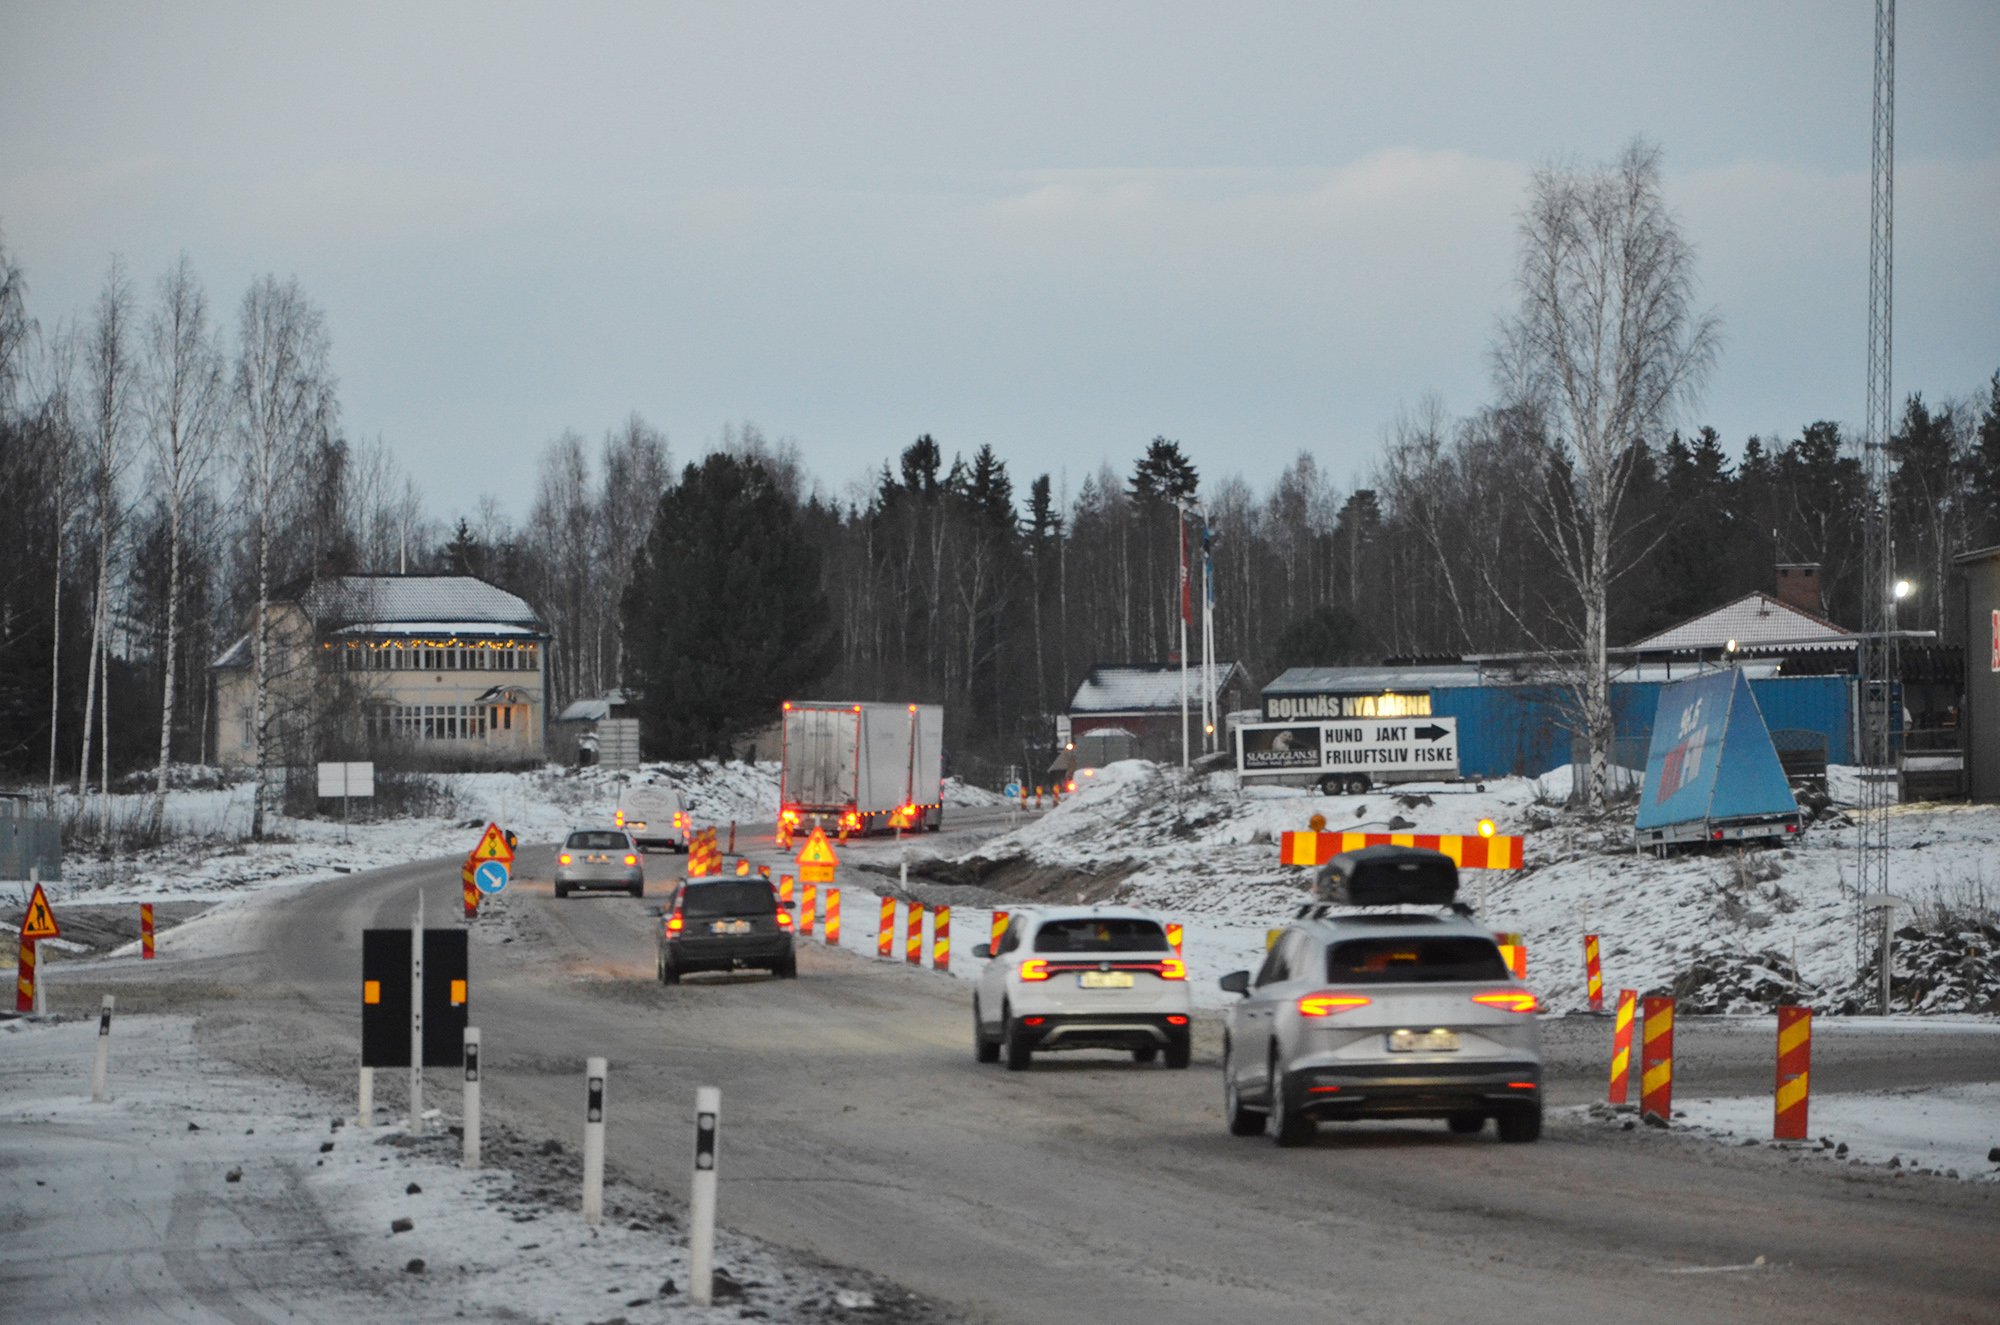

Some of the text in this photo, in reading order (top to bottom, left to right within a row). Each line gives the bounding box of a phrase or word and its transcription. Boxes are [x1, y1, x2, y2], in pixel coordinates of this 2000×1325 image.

[1268, 692, 1431, 718] BOLLNÄS NYA JÄRNH
[1325, 727, 1408, 743] HUND JAKT
[1326, 747, 1453, 765] FRILUFTSLIV FISKE
